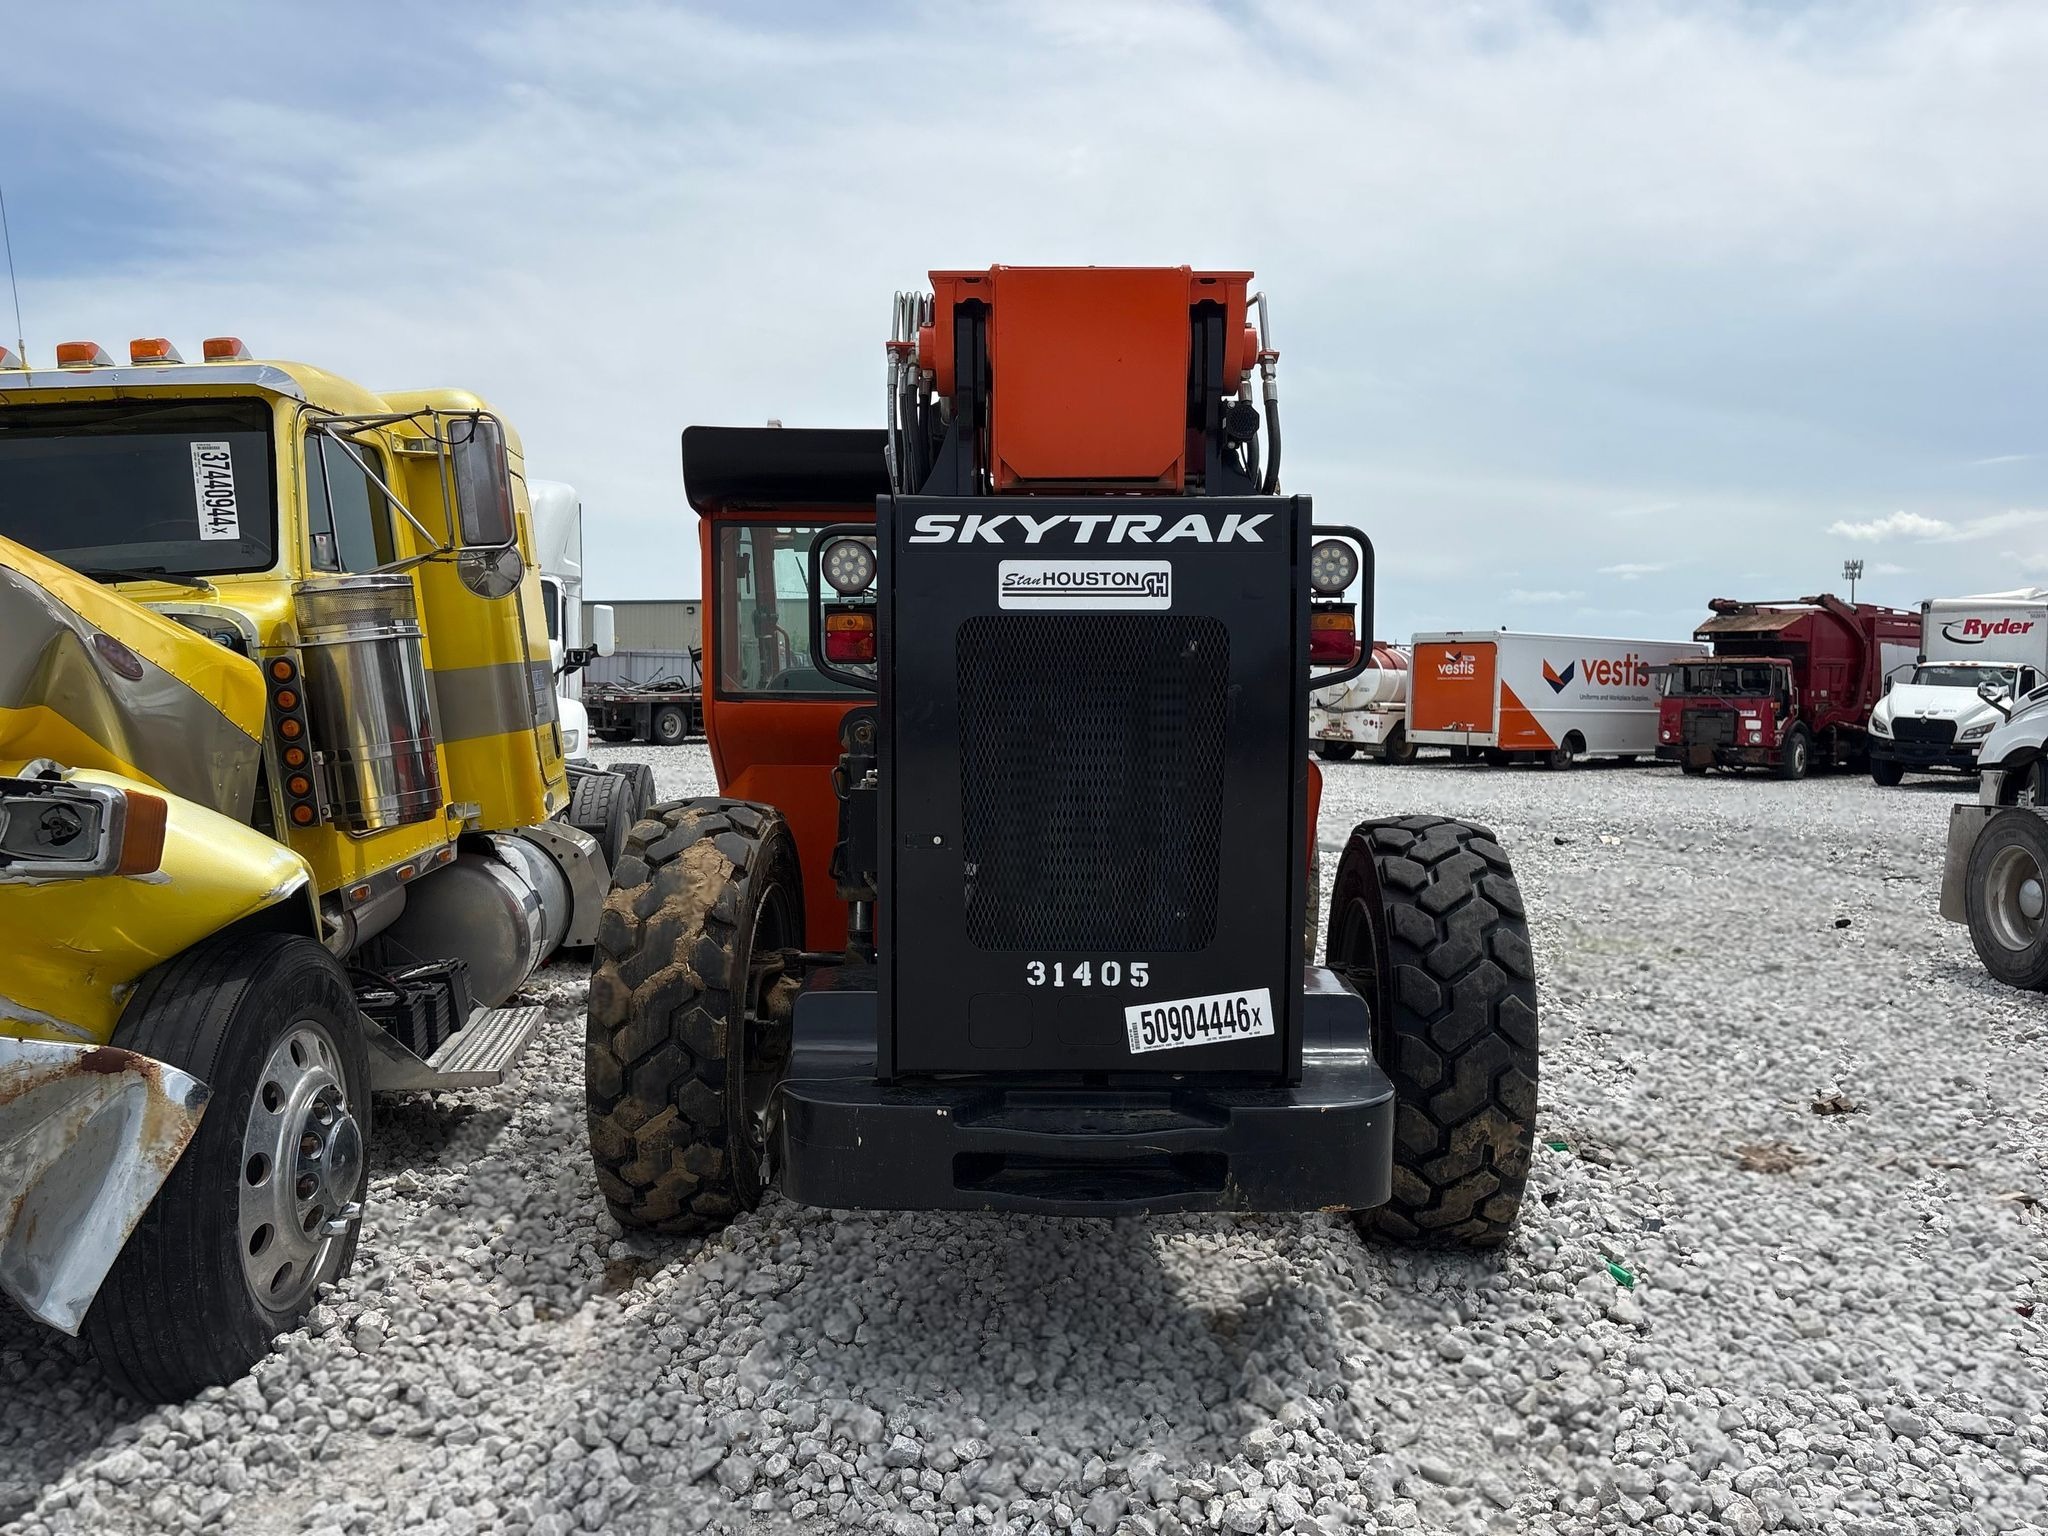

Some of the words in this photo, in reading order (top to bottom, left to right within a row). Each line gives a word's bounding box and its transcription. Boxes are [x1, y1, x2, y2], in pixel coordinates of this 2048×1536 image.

[908, 514, 1275, 544] SKYTRAK
[1002, 573, 1042, 586] Stan
[1043, 572, 1139, 586] HOUSTON
[1962, 618, 2035, 639] Ryder
[1437, 661, 1475, 675] vestis
[1581, 653, 1650, 687] vestis
[1026, 961, 1150, 988] 31405
